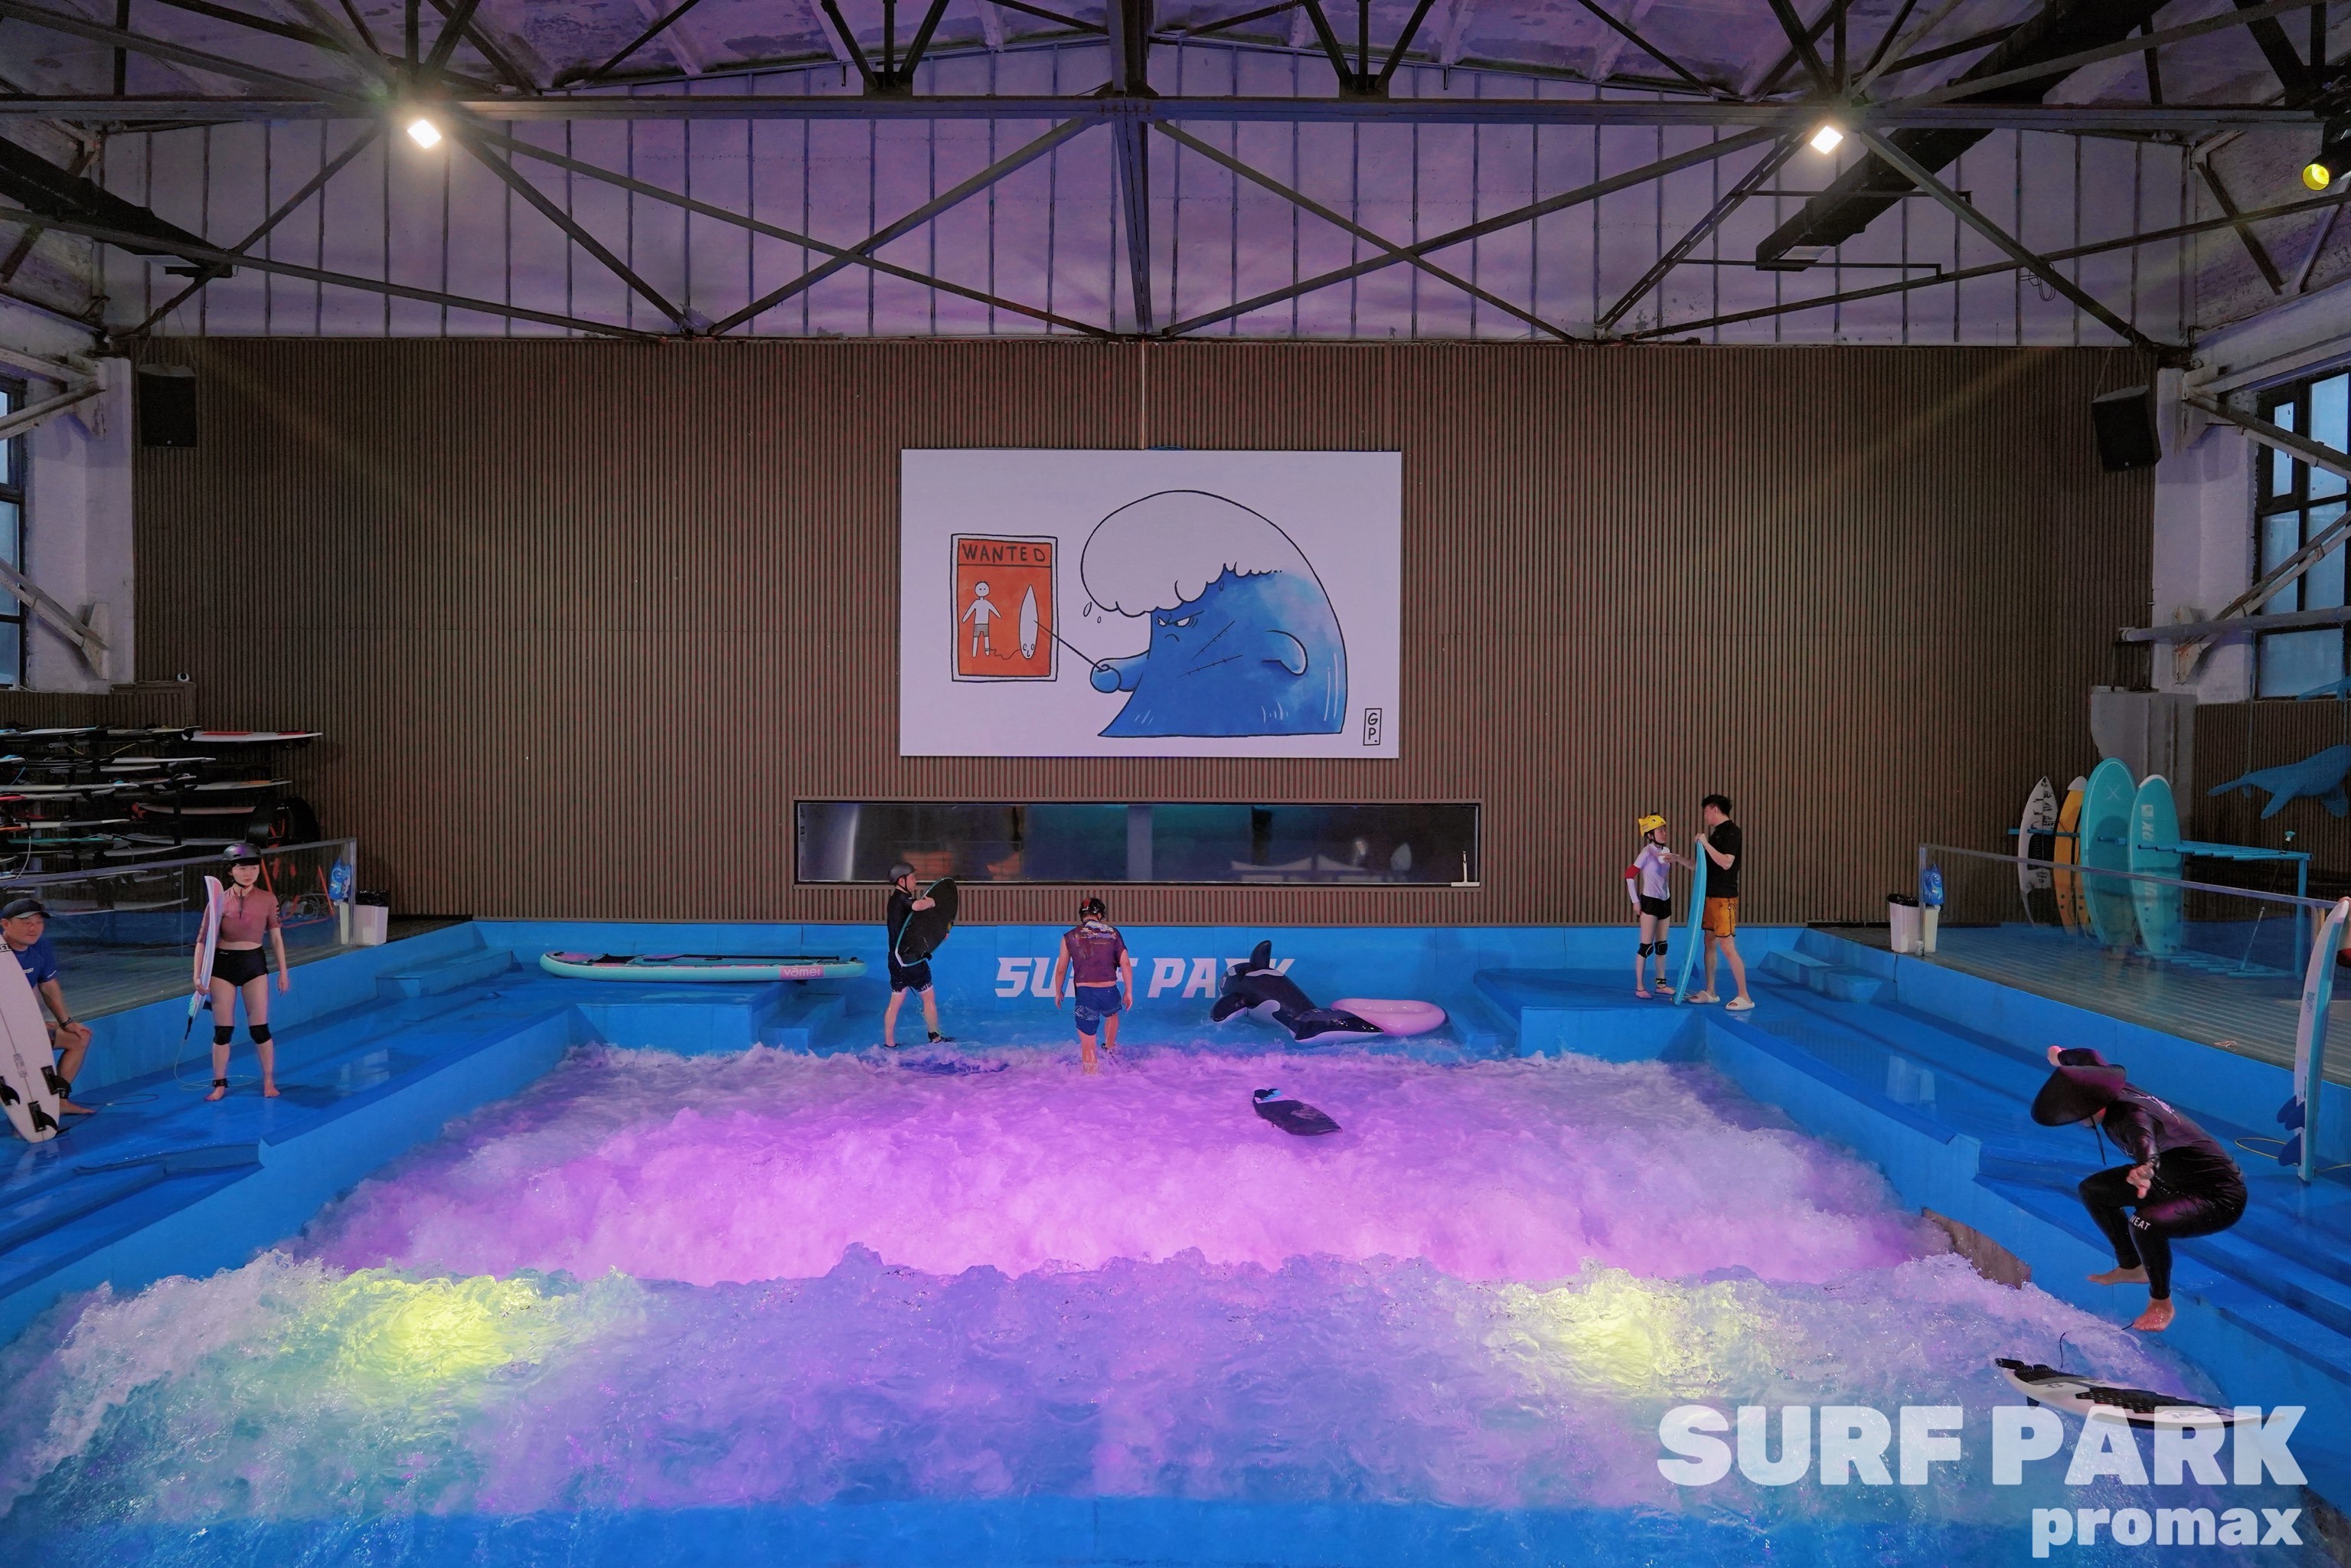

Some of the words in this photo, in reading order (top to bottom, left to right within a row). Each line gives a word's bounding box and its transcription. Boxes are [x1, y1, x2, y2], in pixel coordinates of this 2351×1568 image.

[962, 544, 1046, 564] WANTED
[995, 957, 1137, 998] SU
[1148, 957, 1296, 998] PA
